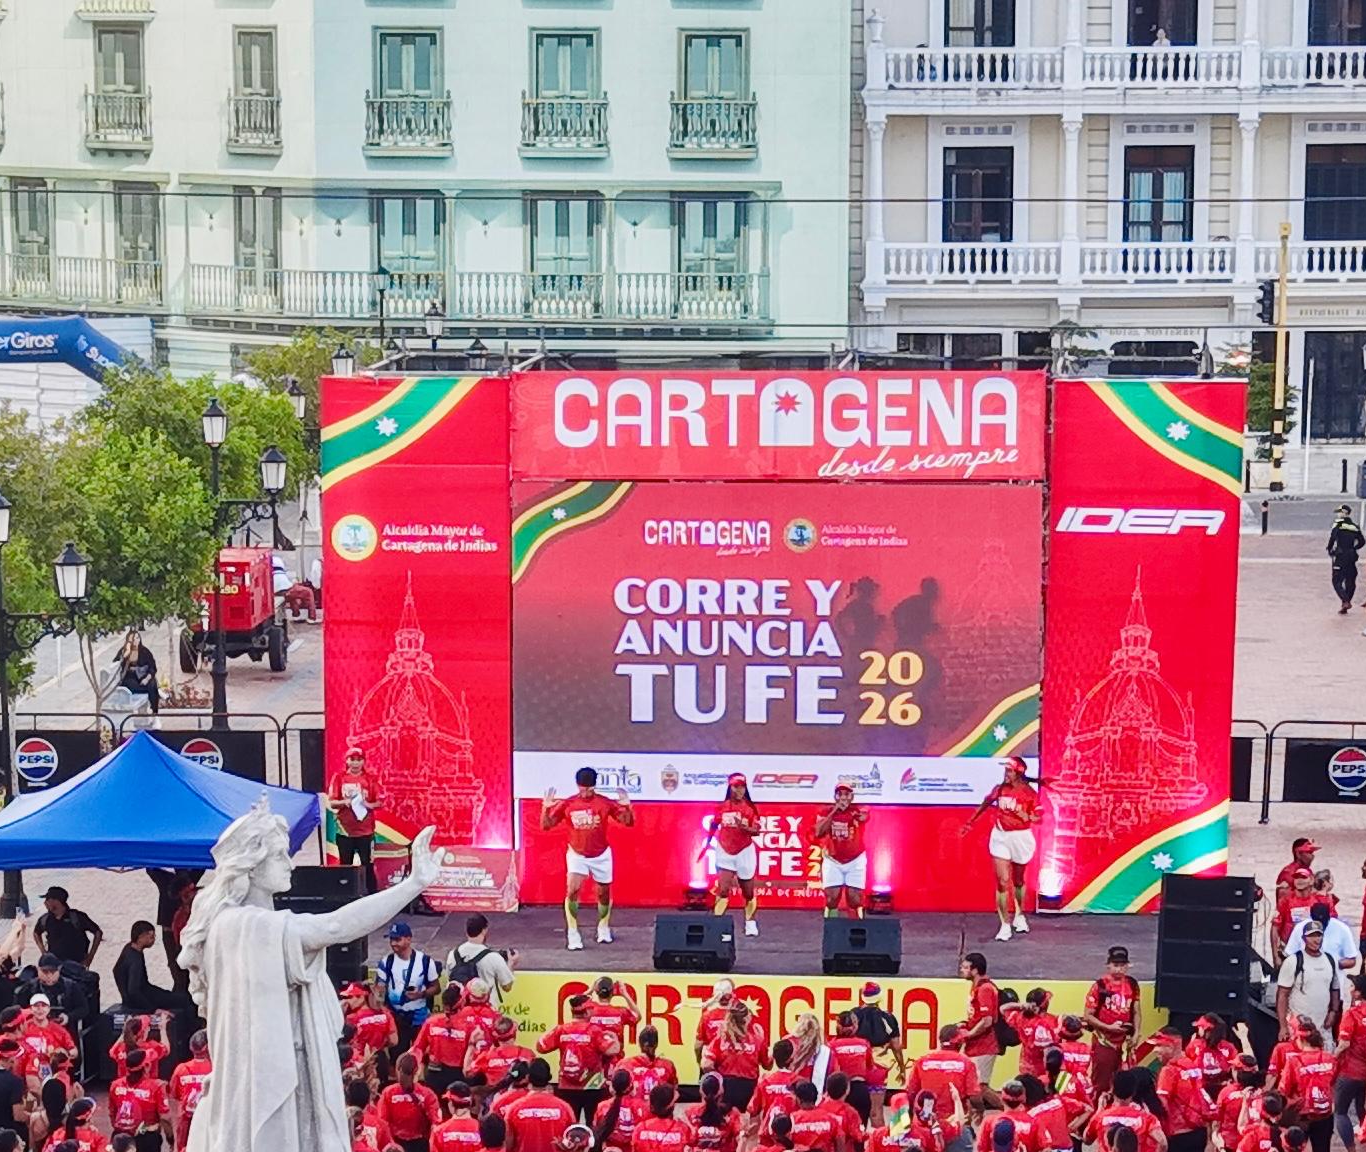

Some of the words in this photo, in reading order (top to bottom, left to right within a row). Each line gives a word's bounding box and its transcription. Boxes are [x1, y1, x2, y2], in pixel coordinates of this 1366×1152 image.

[554, 377, 1018, 447] CARTAGENA
[818, 446, 896, 477] desde
[899, 447, 1020, 479] siempre
[613, 577, 792, 616] CORRE
[804, 579, 842, 616] Y
[614, 619, 843, 657] ANUNCIA
[858, 651, 924, 687] 20
[614, 663, 727, 724] TU
[744, 664, 846, 725] FE
[858, 691, 923, 726] 26
[18, 754, 55, 764] PEPSI
[519, 1021, 546, 1033] dias
